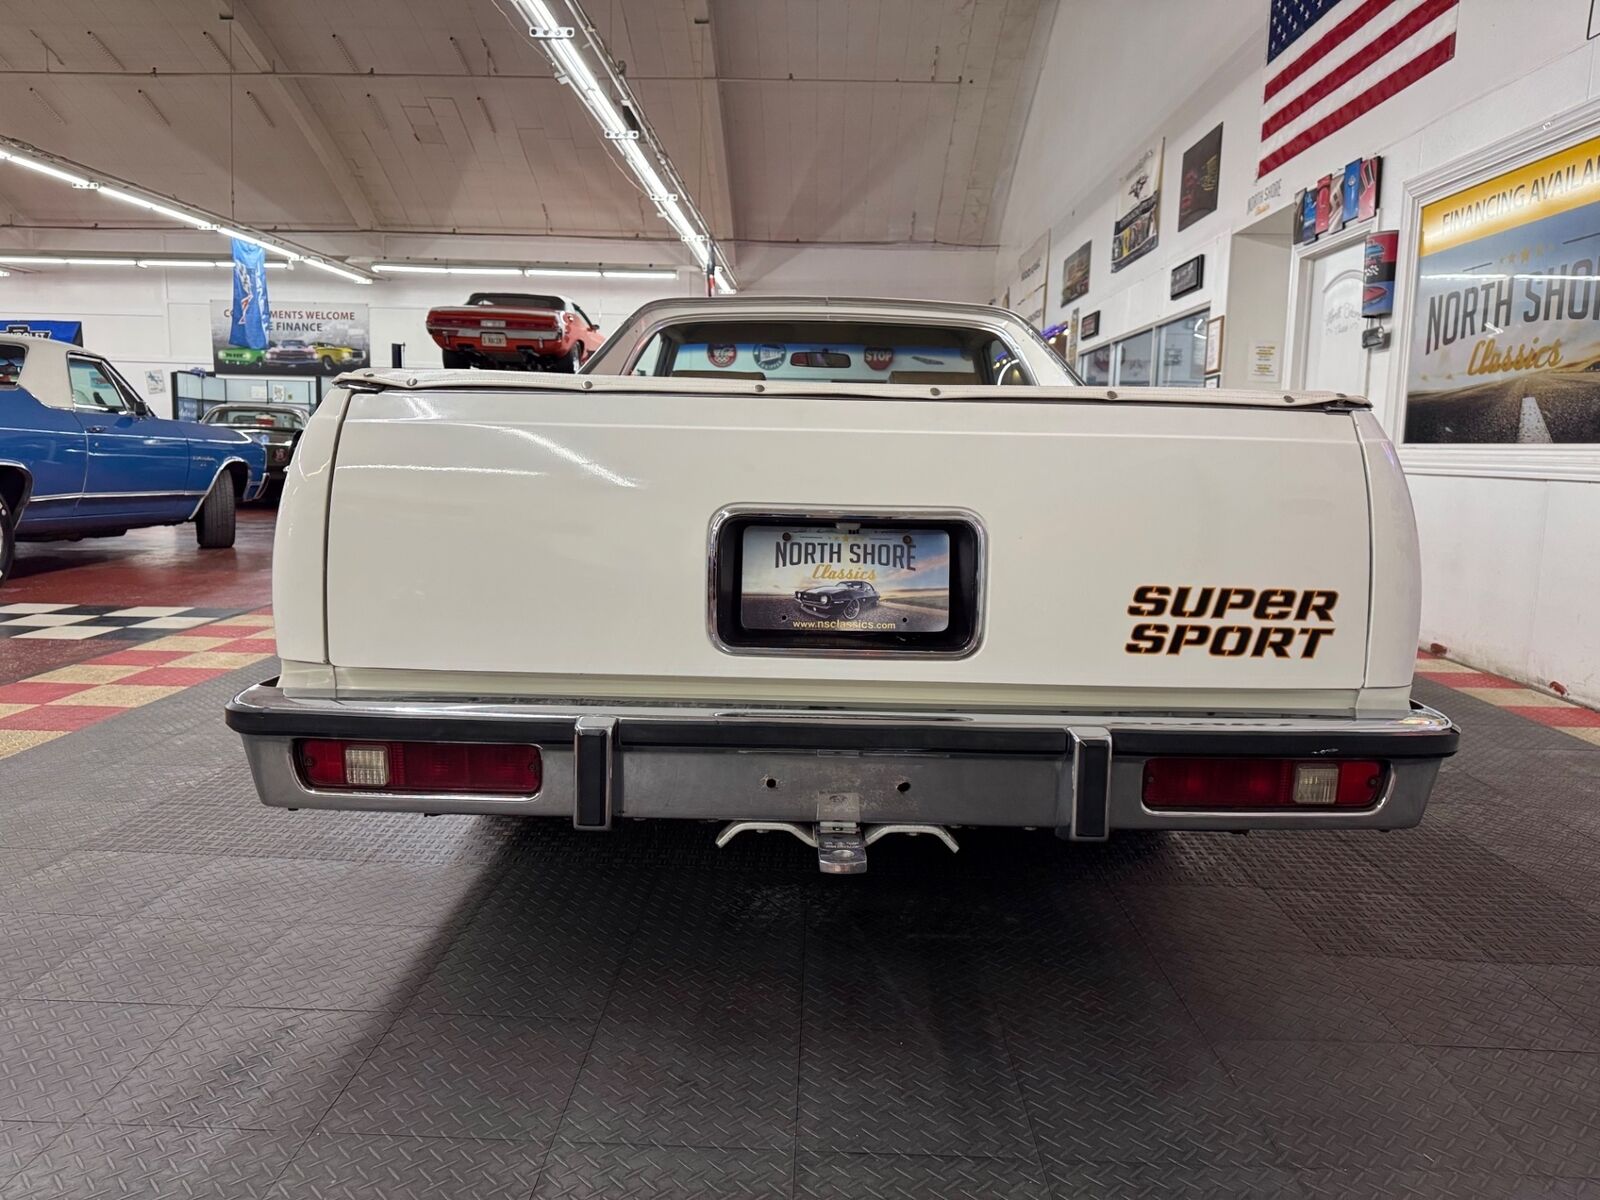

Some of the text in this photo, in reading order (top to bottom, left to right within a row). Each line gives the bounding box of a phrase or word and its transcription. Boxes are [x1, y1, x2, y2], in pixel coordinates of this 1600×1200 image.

[1442, 153, 1600, 234] FINANCING AVAILA
[305, 311, 356, 321] WELCOME
[1425, 275, 1514, 356] NORTH
[1522, 257, 1600, 323] SHO
[276, 322, 323, 332] FINANCE
[865, 350, 893, 362] STOP
[1467, 337, 1564, 376] Classics
[775, 541, 917, 572] NORTH SHORE
[811, 564, 876, 581] Classics
[792, 619, 896, 630] www.nsclassics.com
[1125, 623, 1336, 658] SPORT
